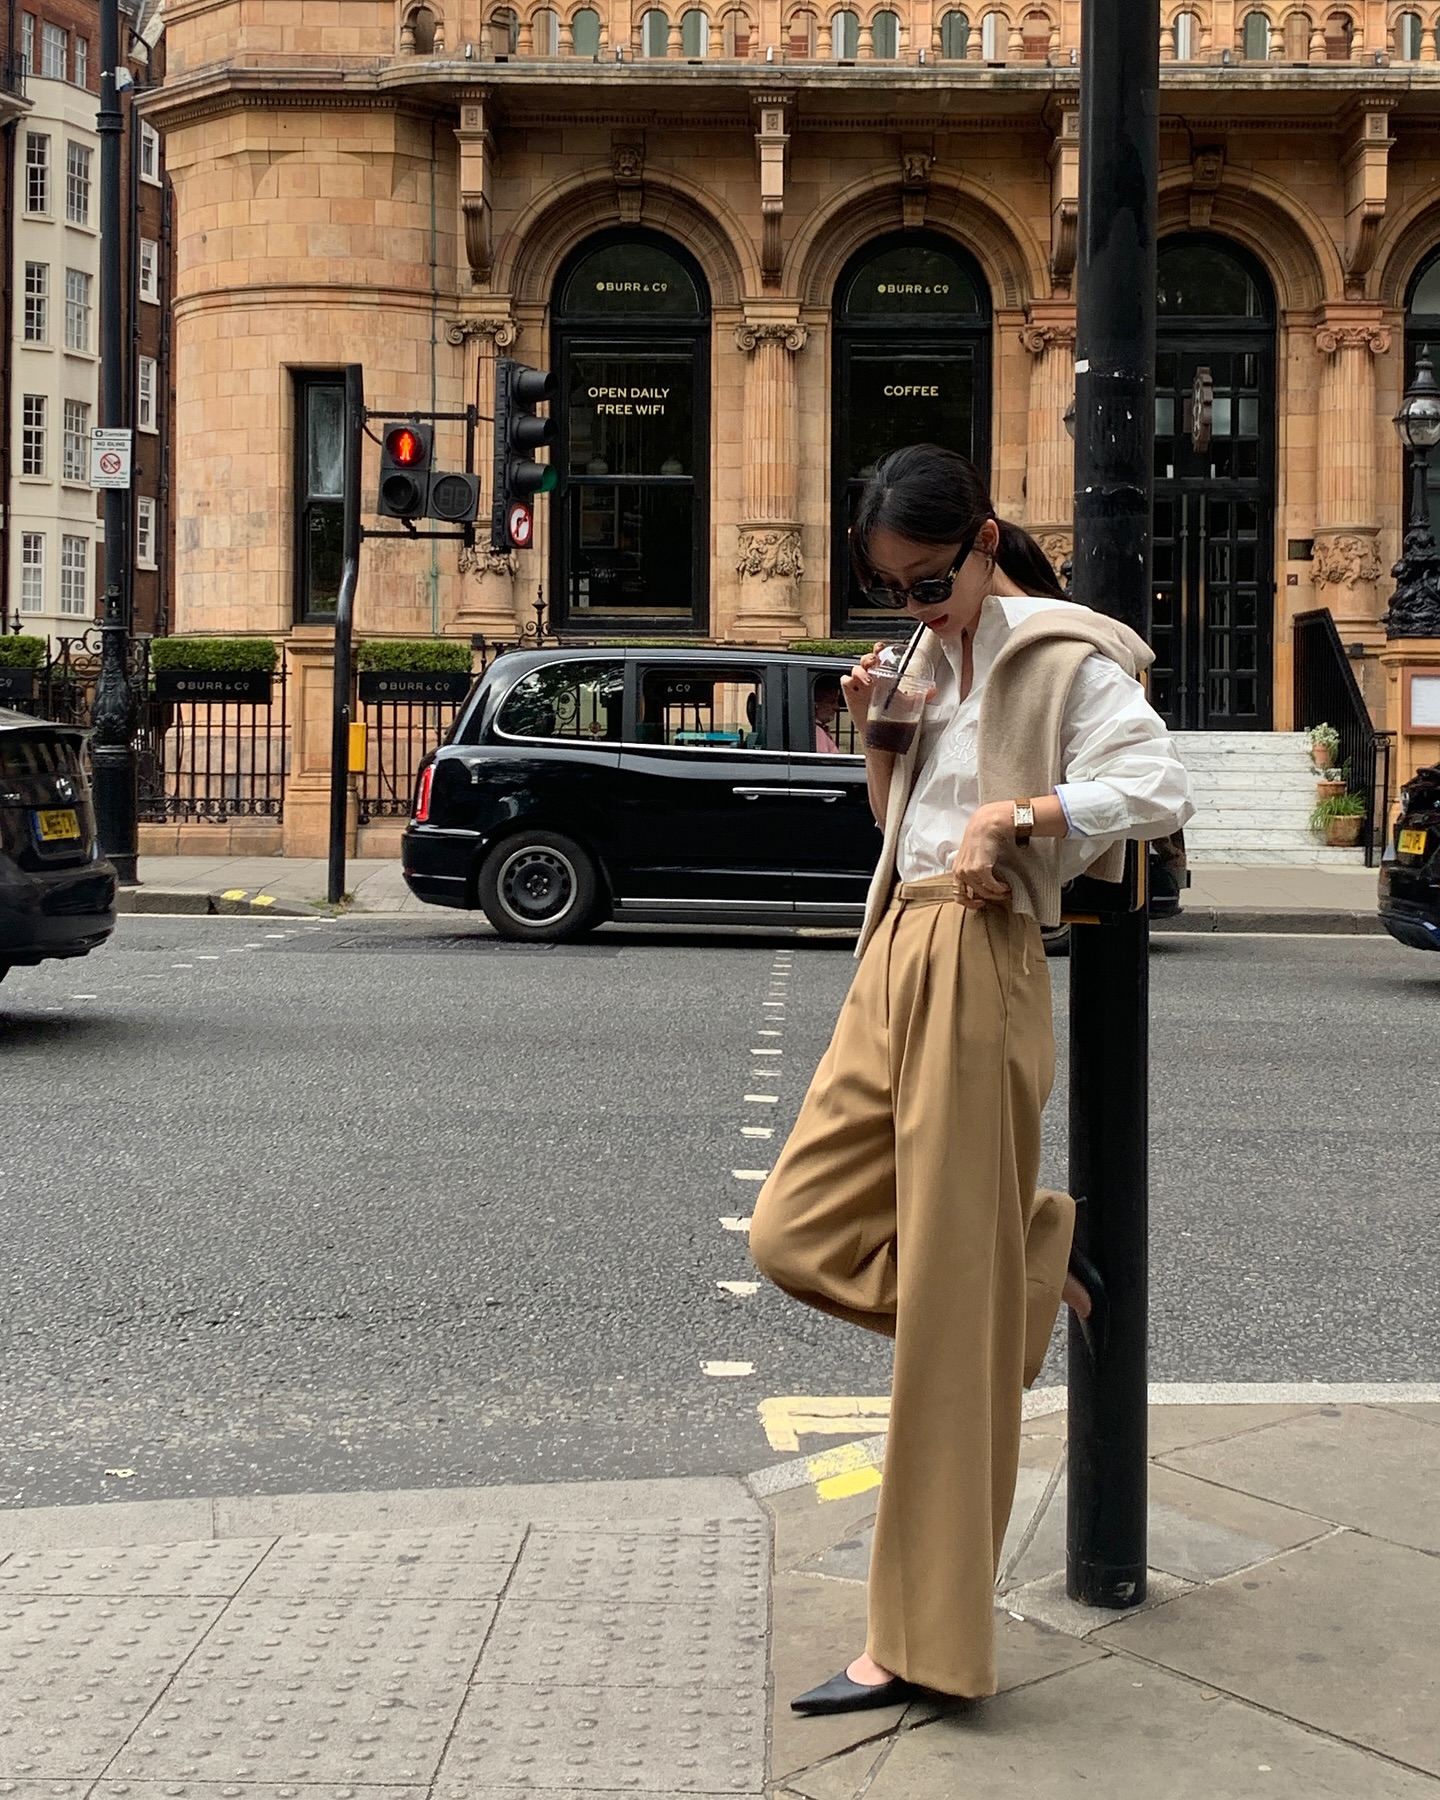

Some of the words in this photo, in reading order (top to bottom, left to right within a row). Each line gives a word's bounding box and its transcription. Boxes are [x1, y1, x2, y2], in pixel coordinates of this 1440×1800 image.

[606, 282, 641, 291] BURR
[643, 284, 650, 292] &
[887, 284, 922, 293] BURR
[924, 286, 931, 294] &
[588, 387, 627, 398] OPEN
[630, 388, 670, 398] DAILY
[884, 385, 939, 396] COFFEE
[597, 404, 633, 415] FREE
[635, 404, 665, 415] WIFI
[187, 681, 223, 690] BURR
[389, 682, 423, 690] BURR
